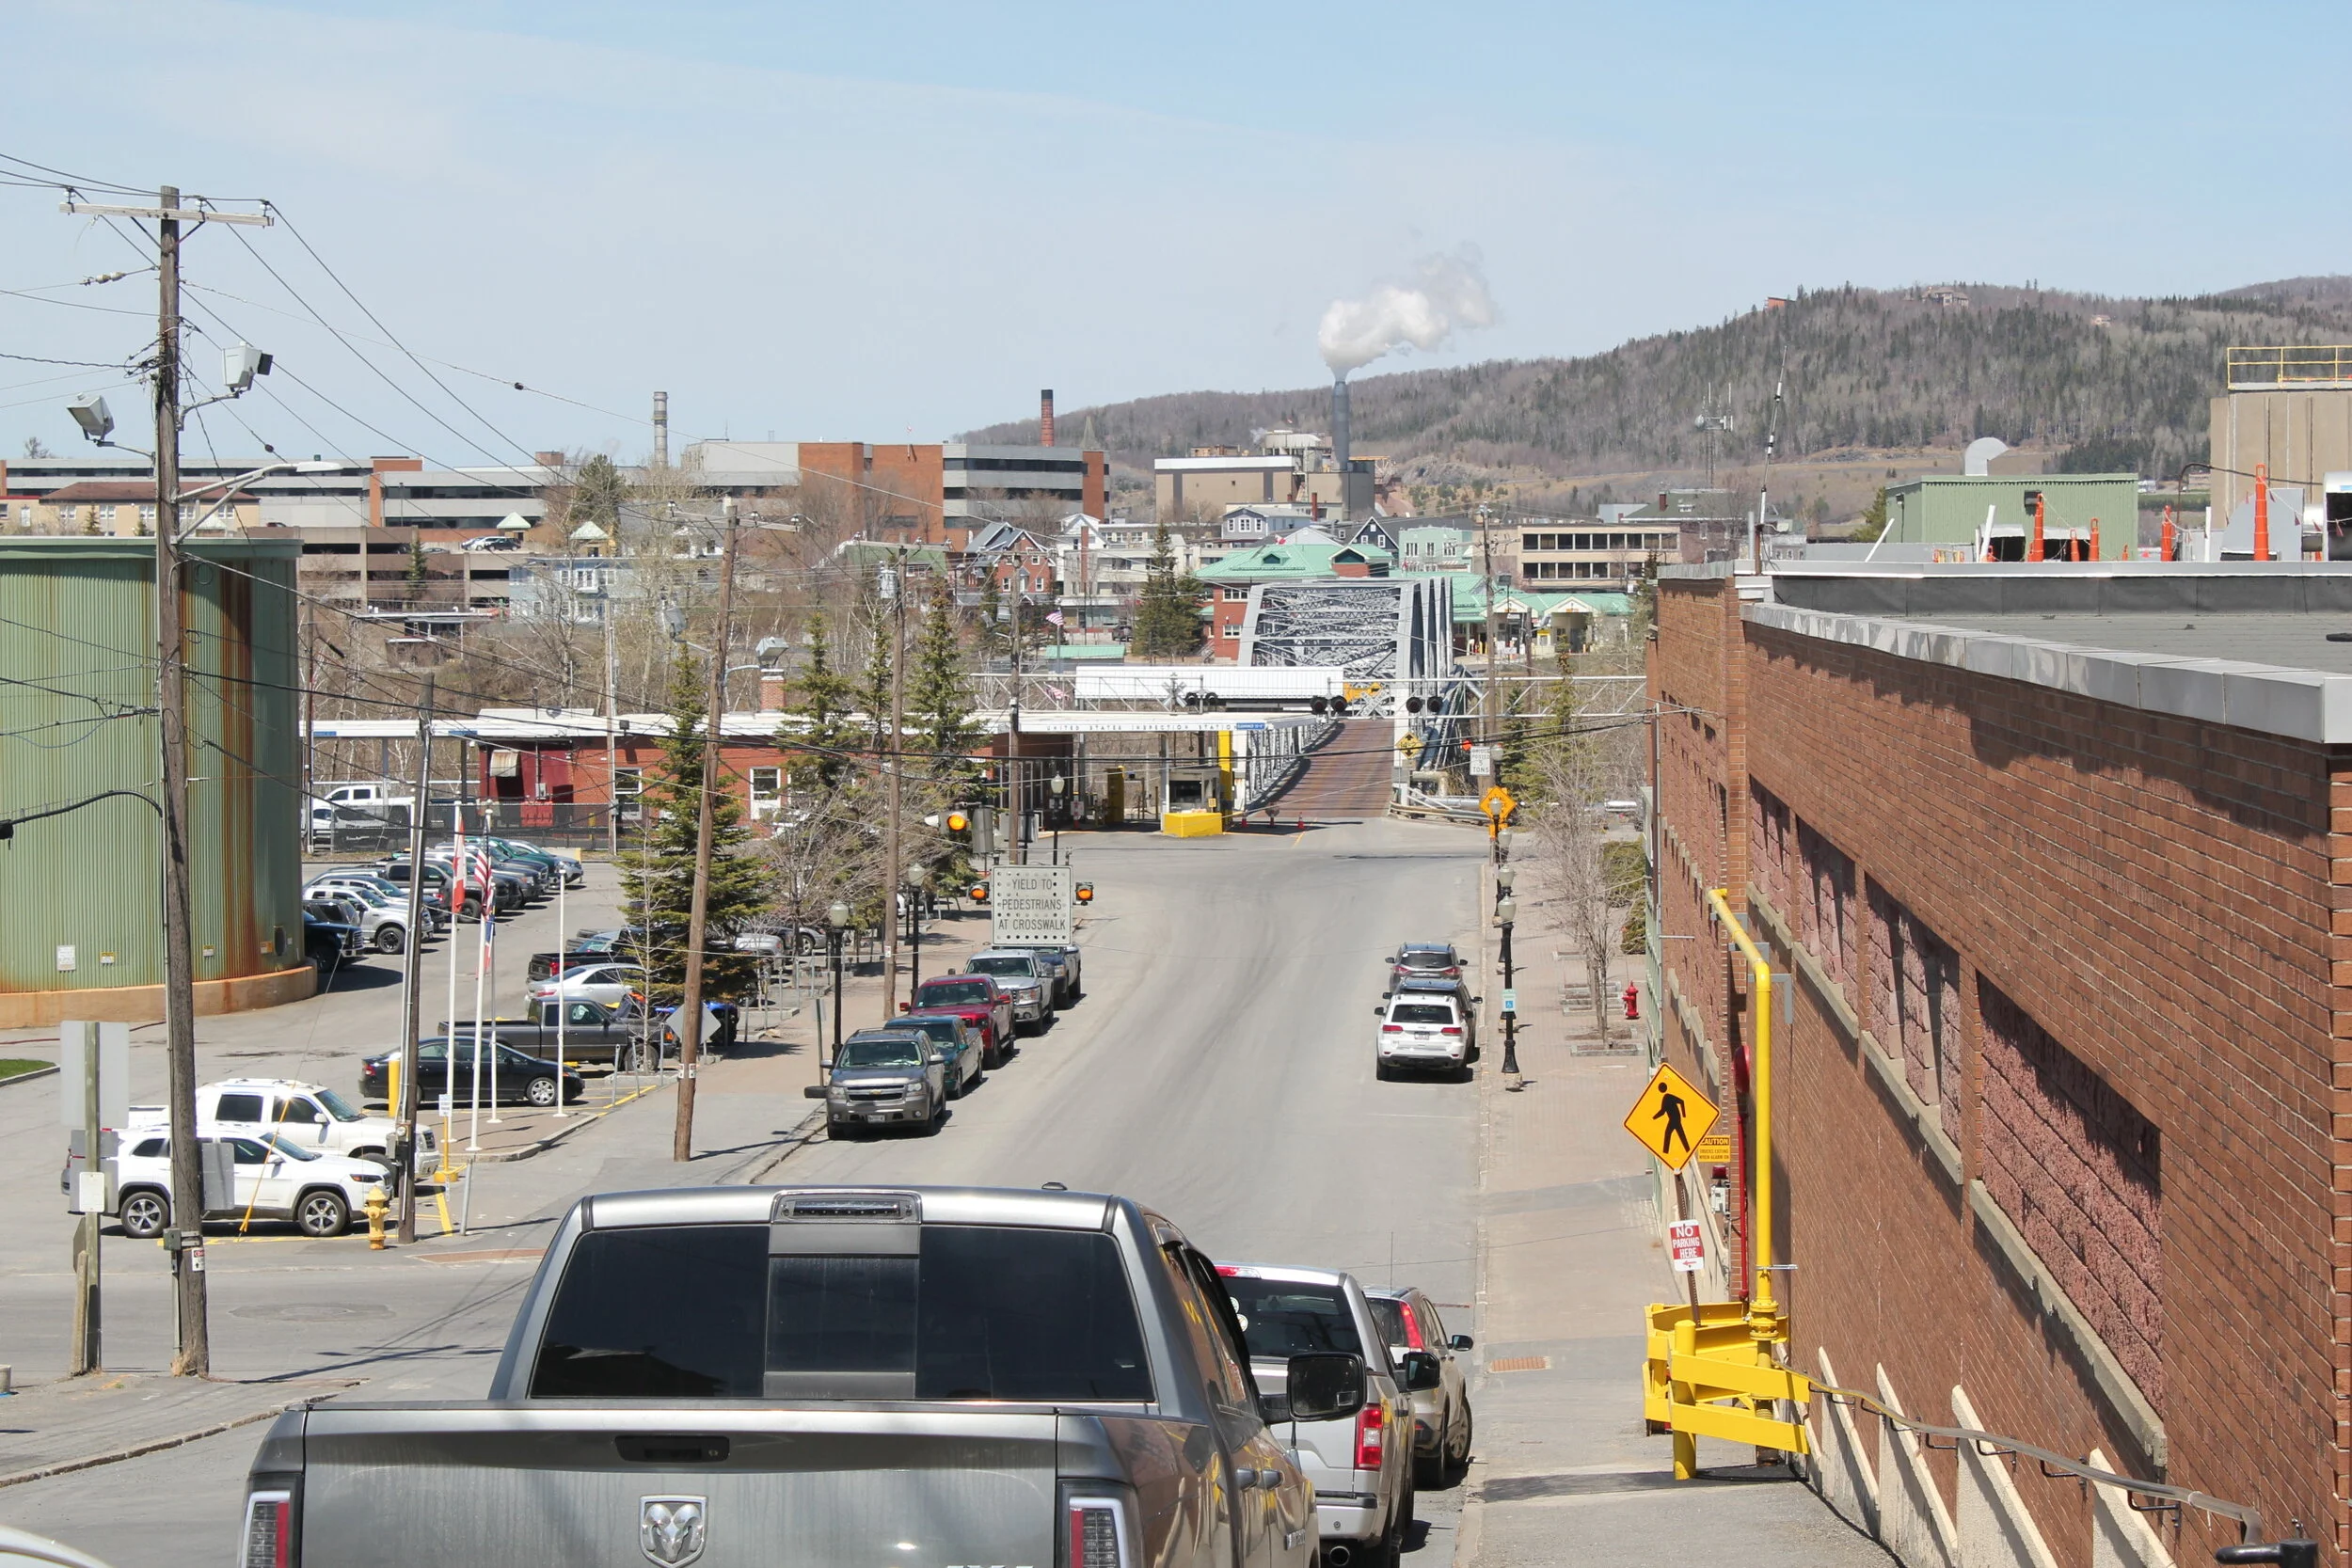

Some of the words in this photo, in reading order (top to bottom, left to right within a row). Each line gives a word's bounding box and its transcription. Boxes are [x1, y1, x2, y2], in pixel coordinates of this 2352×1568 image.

[1011, 879, 1038, 890] YIELD
[1041, 879, 1053, 890] TO
[1002, 899, 1062, 910] PEDESTRIANS
[998, 919, 1009, 930] AT
[1012, 919, 1066, 930] CROSSWALK
[1676, 1226, 1694, 1238] NO
[1673, 1237, 1700, 1249] PARKING
[1678, 1246, 1698, 1259] HERE
